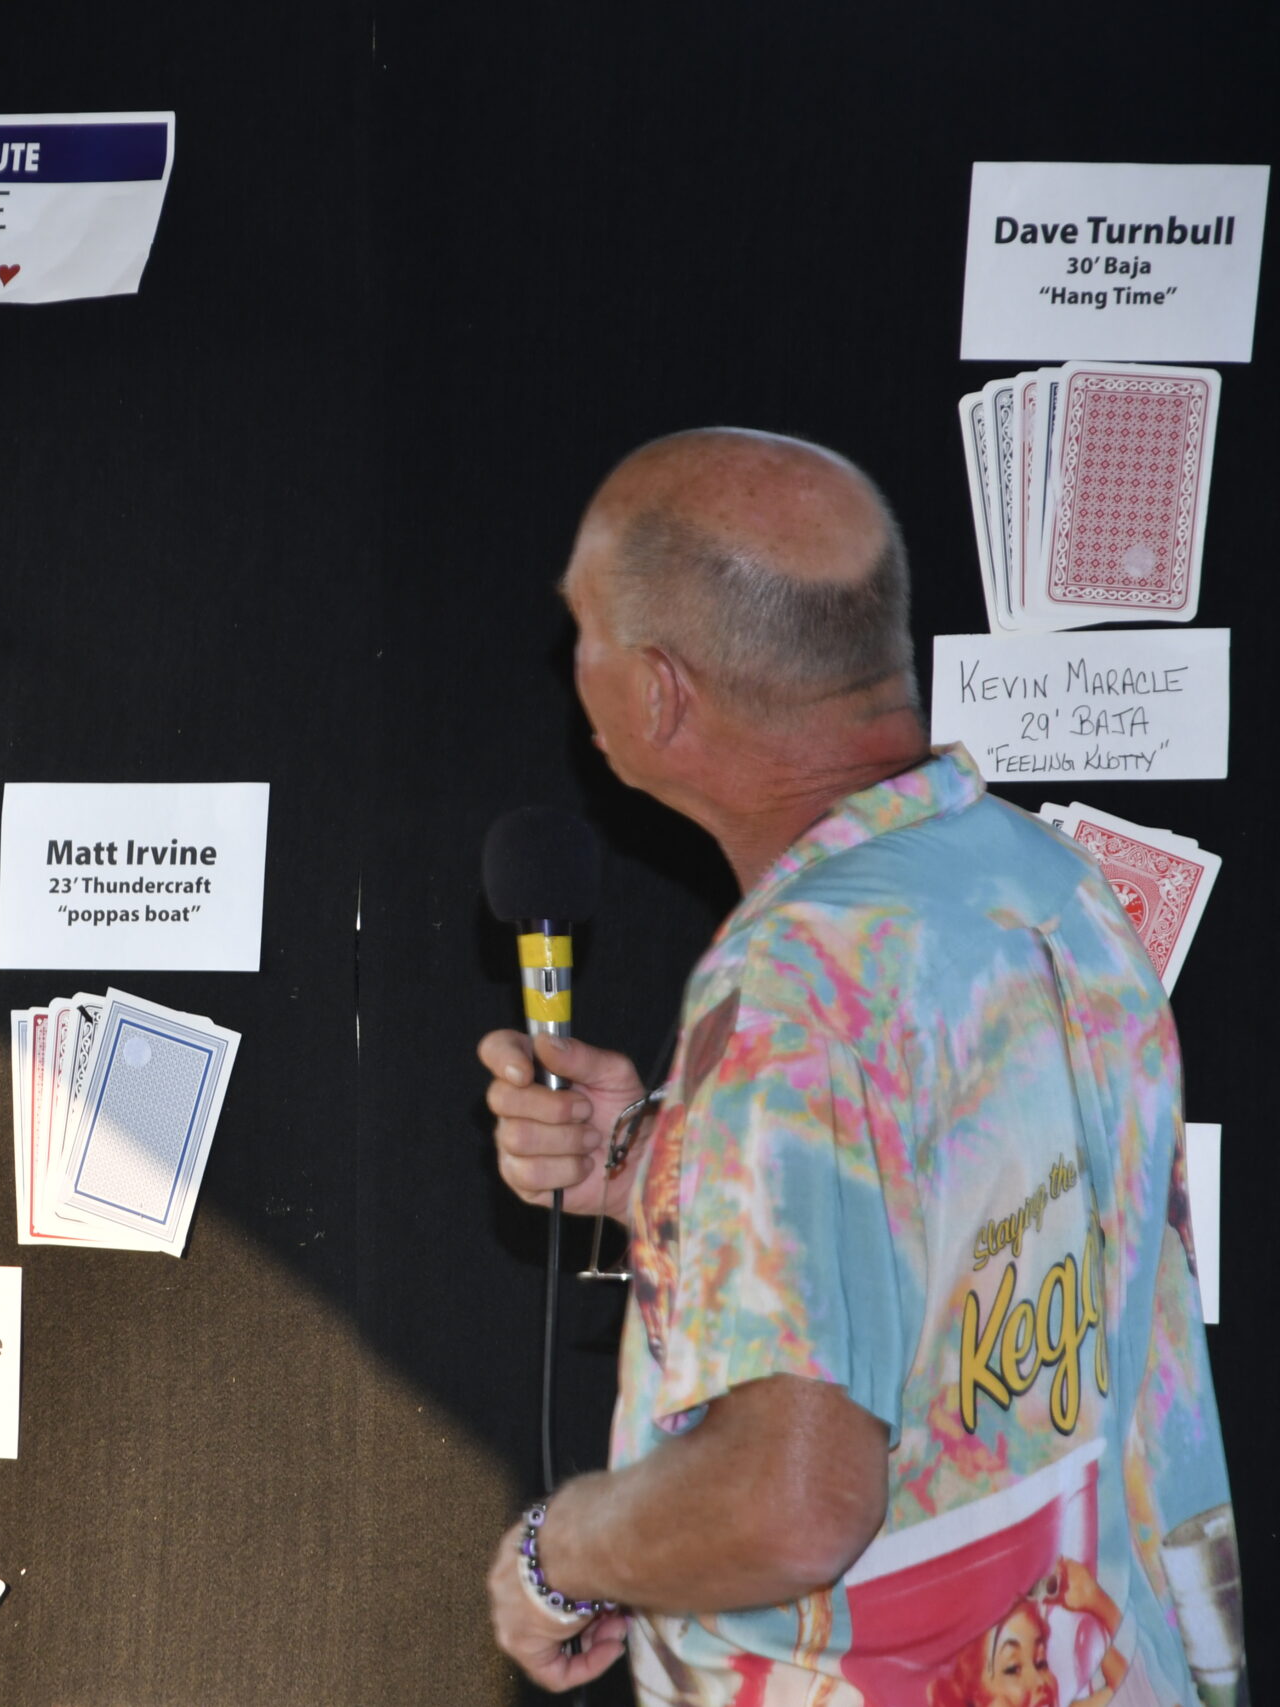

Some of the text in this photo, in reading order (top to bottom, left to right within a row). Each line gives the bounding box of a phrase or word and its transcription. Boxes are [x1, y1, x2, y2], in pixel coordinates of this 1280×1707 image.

[994, 215, 1236, 246] Dave Turnbull
[1066, 255, 1152, 280] 30' Baja
[1039, 286, 1178, 310] “Hang Time”
[960, 657, 1189, 704] KEVIN MARACLE
[1020, 704, 1150, 741] 29' BAJA
[987, 744, 1075, 774] "FEELING
[46, 838, 217, 866] Matt Irvine
[48, 876, 212, 895] 23' Thundercraft
[58, 904, 202, 927] “poppas boat”
[1049, 1152, 1077, 1200] the
